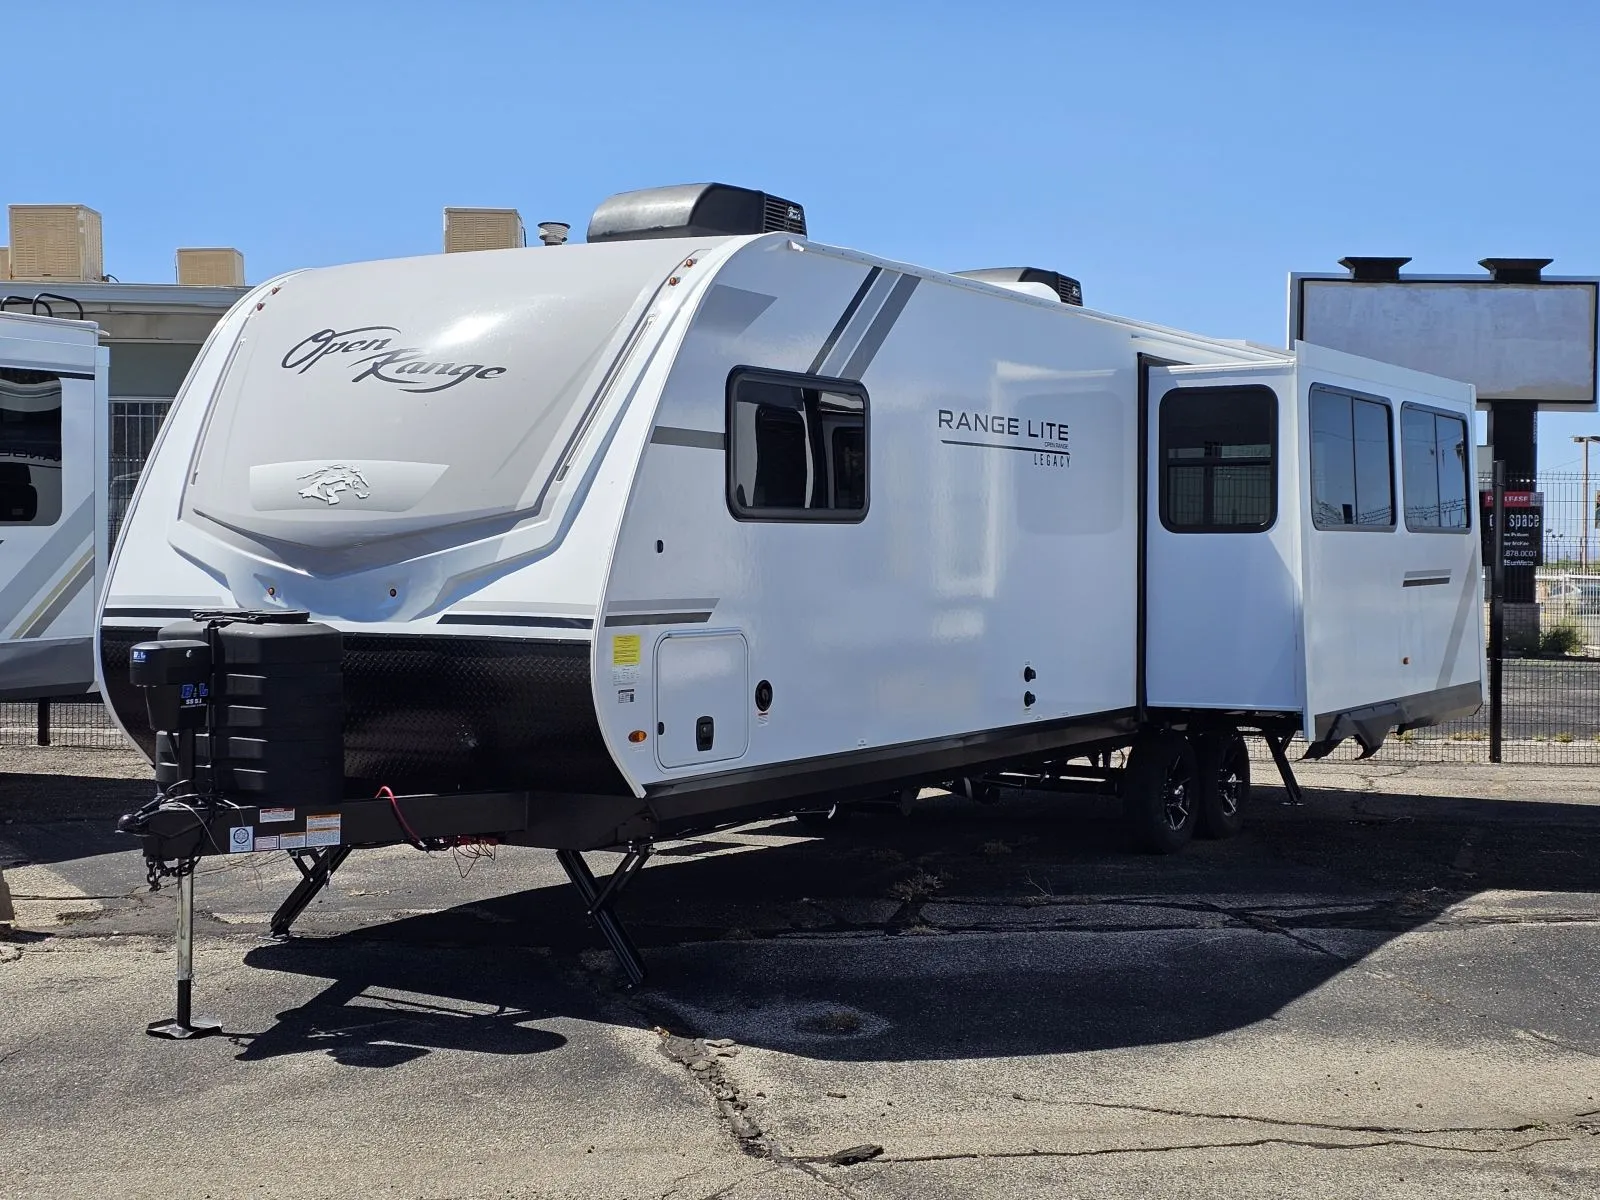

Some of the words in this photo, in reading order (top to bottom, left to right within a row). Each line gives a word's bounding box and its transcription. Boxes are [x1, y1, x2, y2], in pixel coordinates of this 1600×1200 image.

[282, 326, 401, 374] Open
[347, 348, 507, 393] Range
[938, 409, 1019, 436] RANGE
[1028, 419, 1069, 442] LITE
[1033, 453, 1071, 468] LEGACY
[1509, 514, 1540, 530] space
